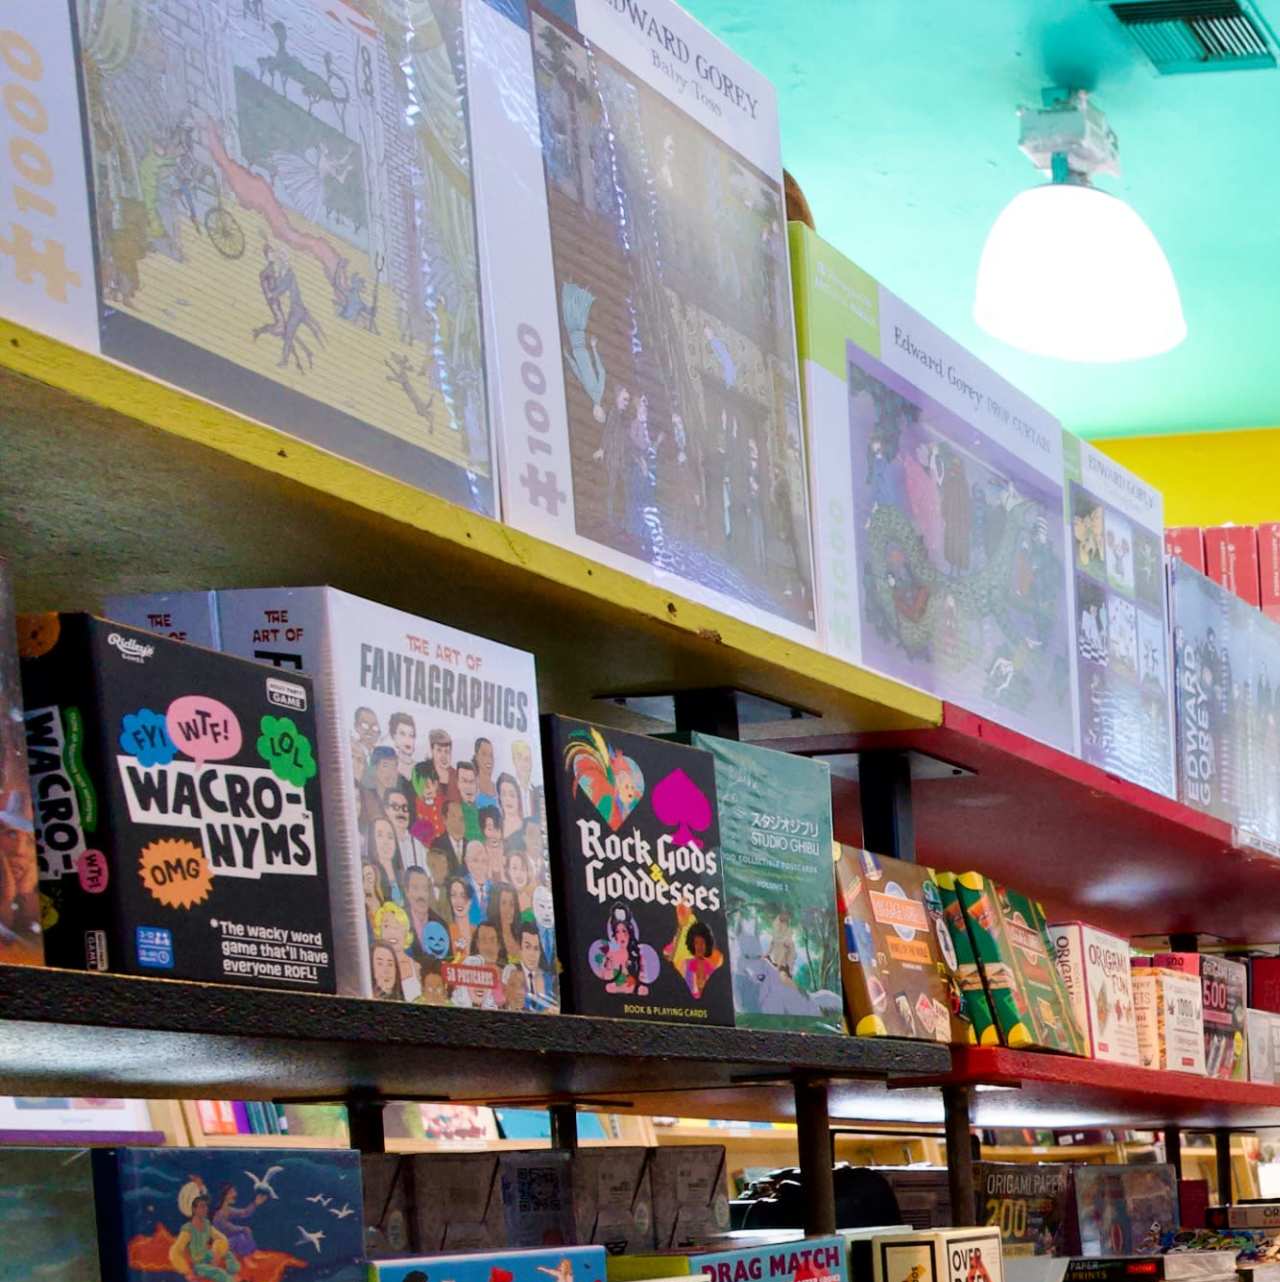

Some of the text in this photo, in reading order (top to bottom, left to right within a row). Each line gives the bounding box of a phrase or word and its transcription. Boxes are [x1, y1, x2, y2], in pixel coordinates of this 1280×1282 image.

[695, 54, 758, 120] GOREY
[893, 325, 944, 379] Edward
[946, 366, 985, 412] Gorey
[252, 627, 305, 645] ART OF
[406, 633, 484, 671] THE ART OF
[359, 642, 530, 733] FANTAGRAPHICS
[132, 724, 168, 751] FYI
[178, 709, 230, 744] WTF!
[1183, 643, 1212, 806] EDWARD GOREY
[269, 732, 304, 769] LOL
[126, 765, 302, 821] WACRO-
[751, 812, 820, 838] スタジオジブリ
[751, 831, 788, 851] STUDIO
[206, 822, 312, 870] NYMS
[576, 818, 718, 877] Rock Gods
[150, 857, 200, 887] OMG
[585, 860, 721, 912] Goddesses
[247, 924, 324, 946] wacky word
[221, 940, 330, 965] game that'll have
[1088, 944, 1129, 977] ORIGAMI
[223, 959, 319, 981] everyone ROFL!
[624, 1003, 708, 1019] BOOK PLAYING CARDS
[1203, 981, 1227, 1010] 500
[985, 1174, 1032, 1195] ORIGAMI
[988, 1200, 1028, 1240] 200
[769, 1246, 840, 1278] MATCH
[951, 1247, 983, 1272] OVER
